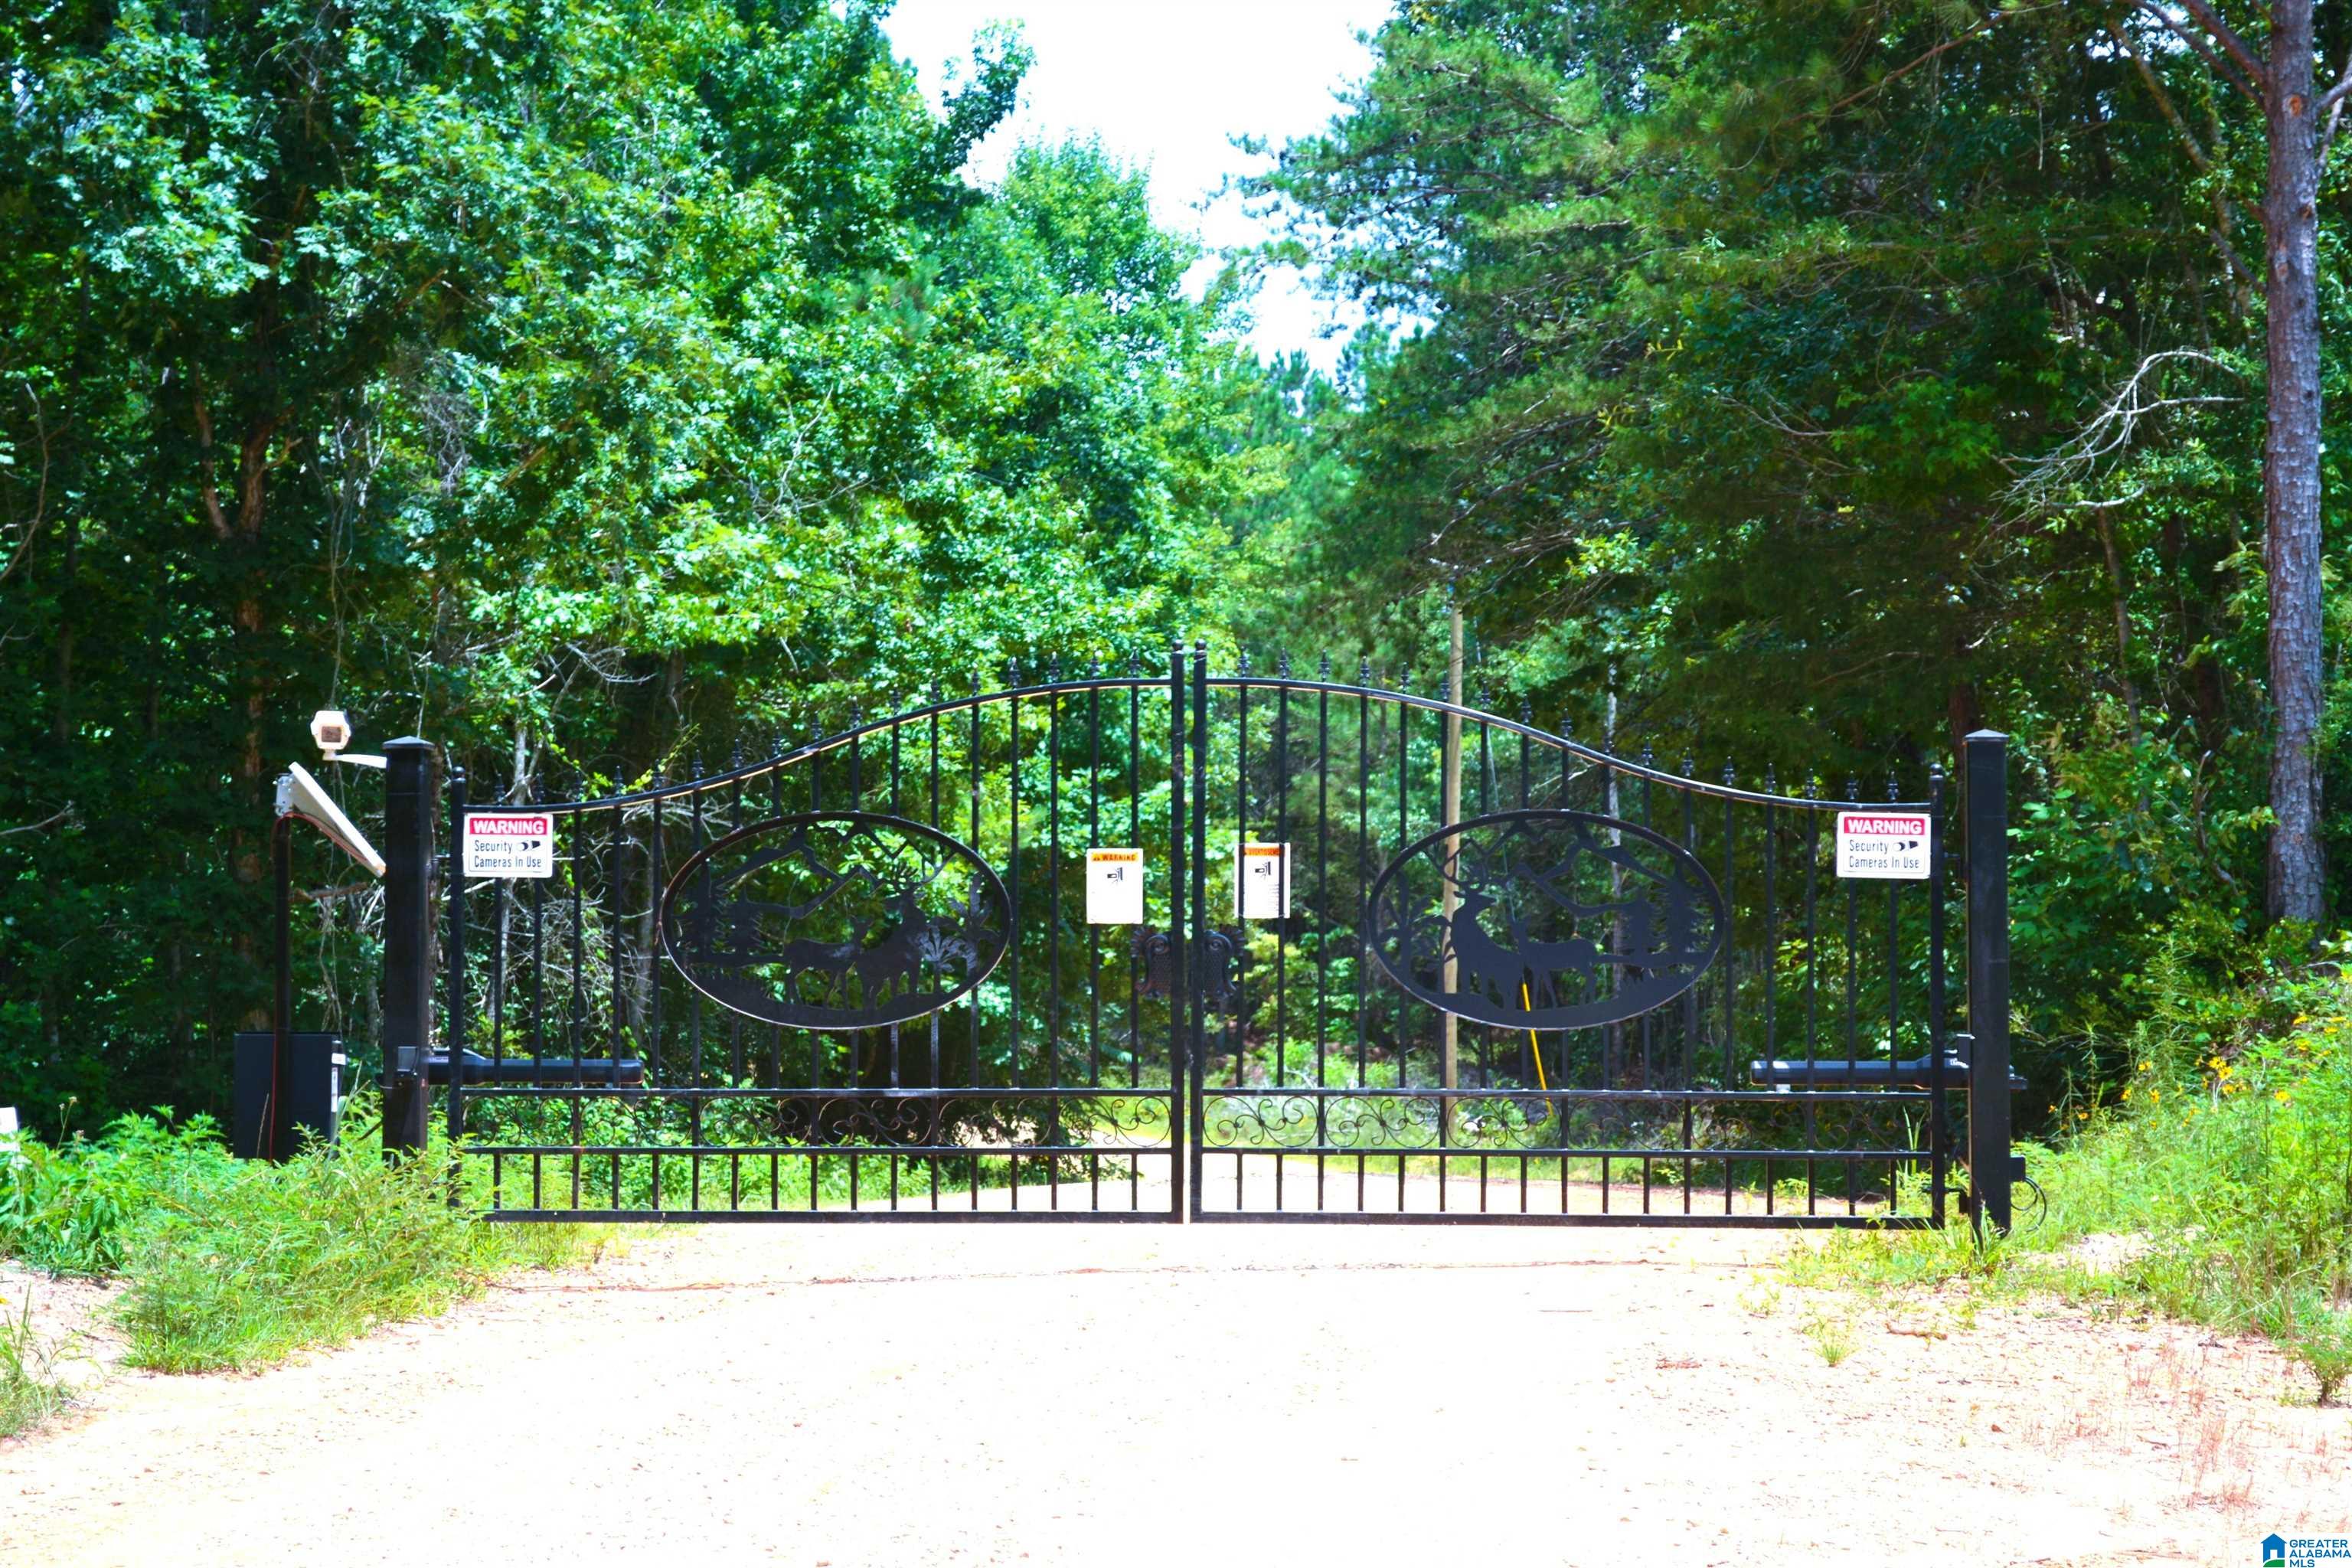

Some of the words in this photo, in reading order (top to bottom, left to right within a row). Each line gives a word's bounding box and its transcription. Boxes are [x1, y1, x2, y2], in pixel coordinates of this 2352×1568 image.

[473, 820, 544, 834] WARNING
[1847, 819, 1922, 835] WARNING
[474, 840, 513, 854] Security
[1849, 839, 1889, 854] Security
[474, 855, 512, 867] Cameras
[515, 856, 524, 867] In
[526, 856, 542, 867] Use
[1849, 856, 1888, 868] Cameras
[1892, 857, 1900, 868] In
[1903, 857, 1920, 868] Use
